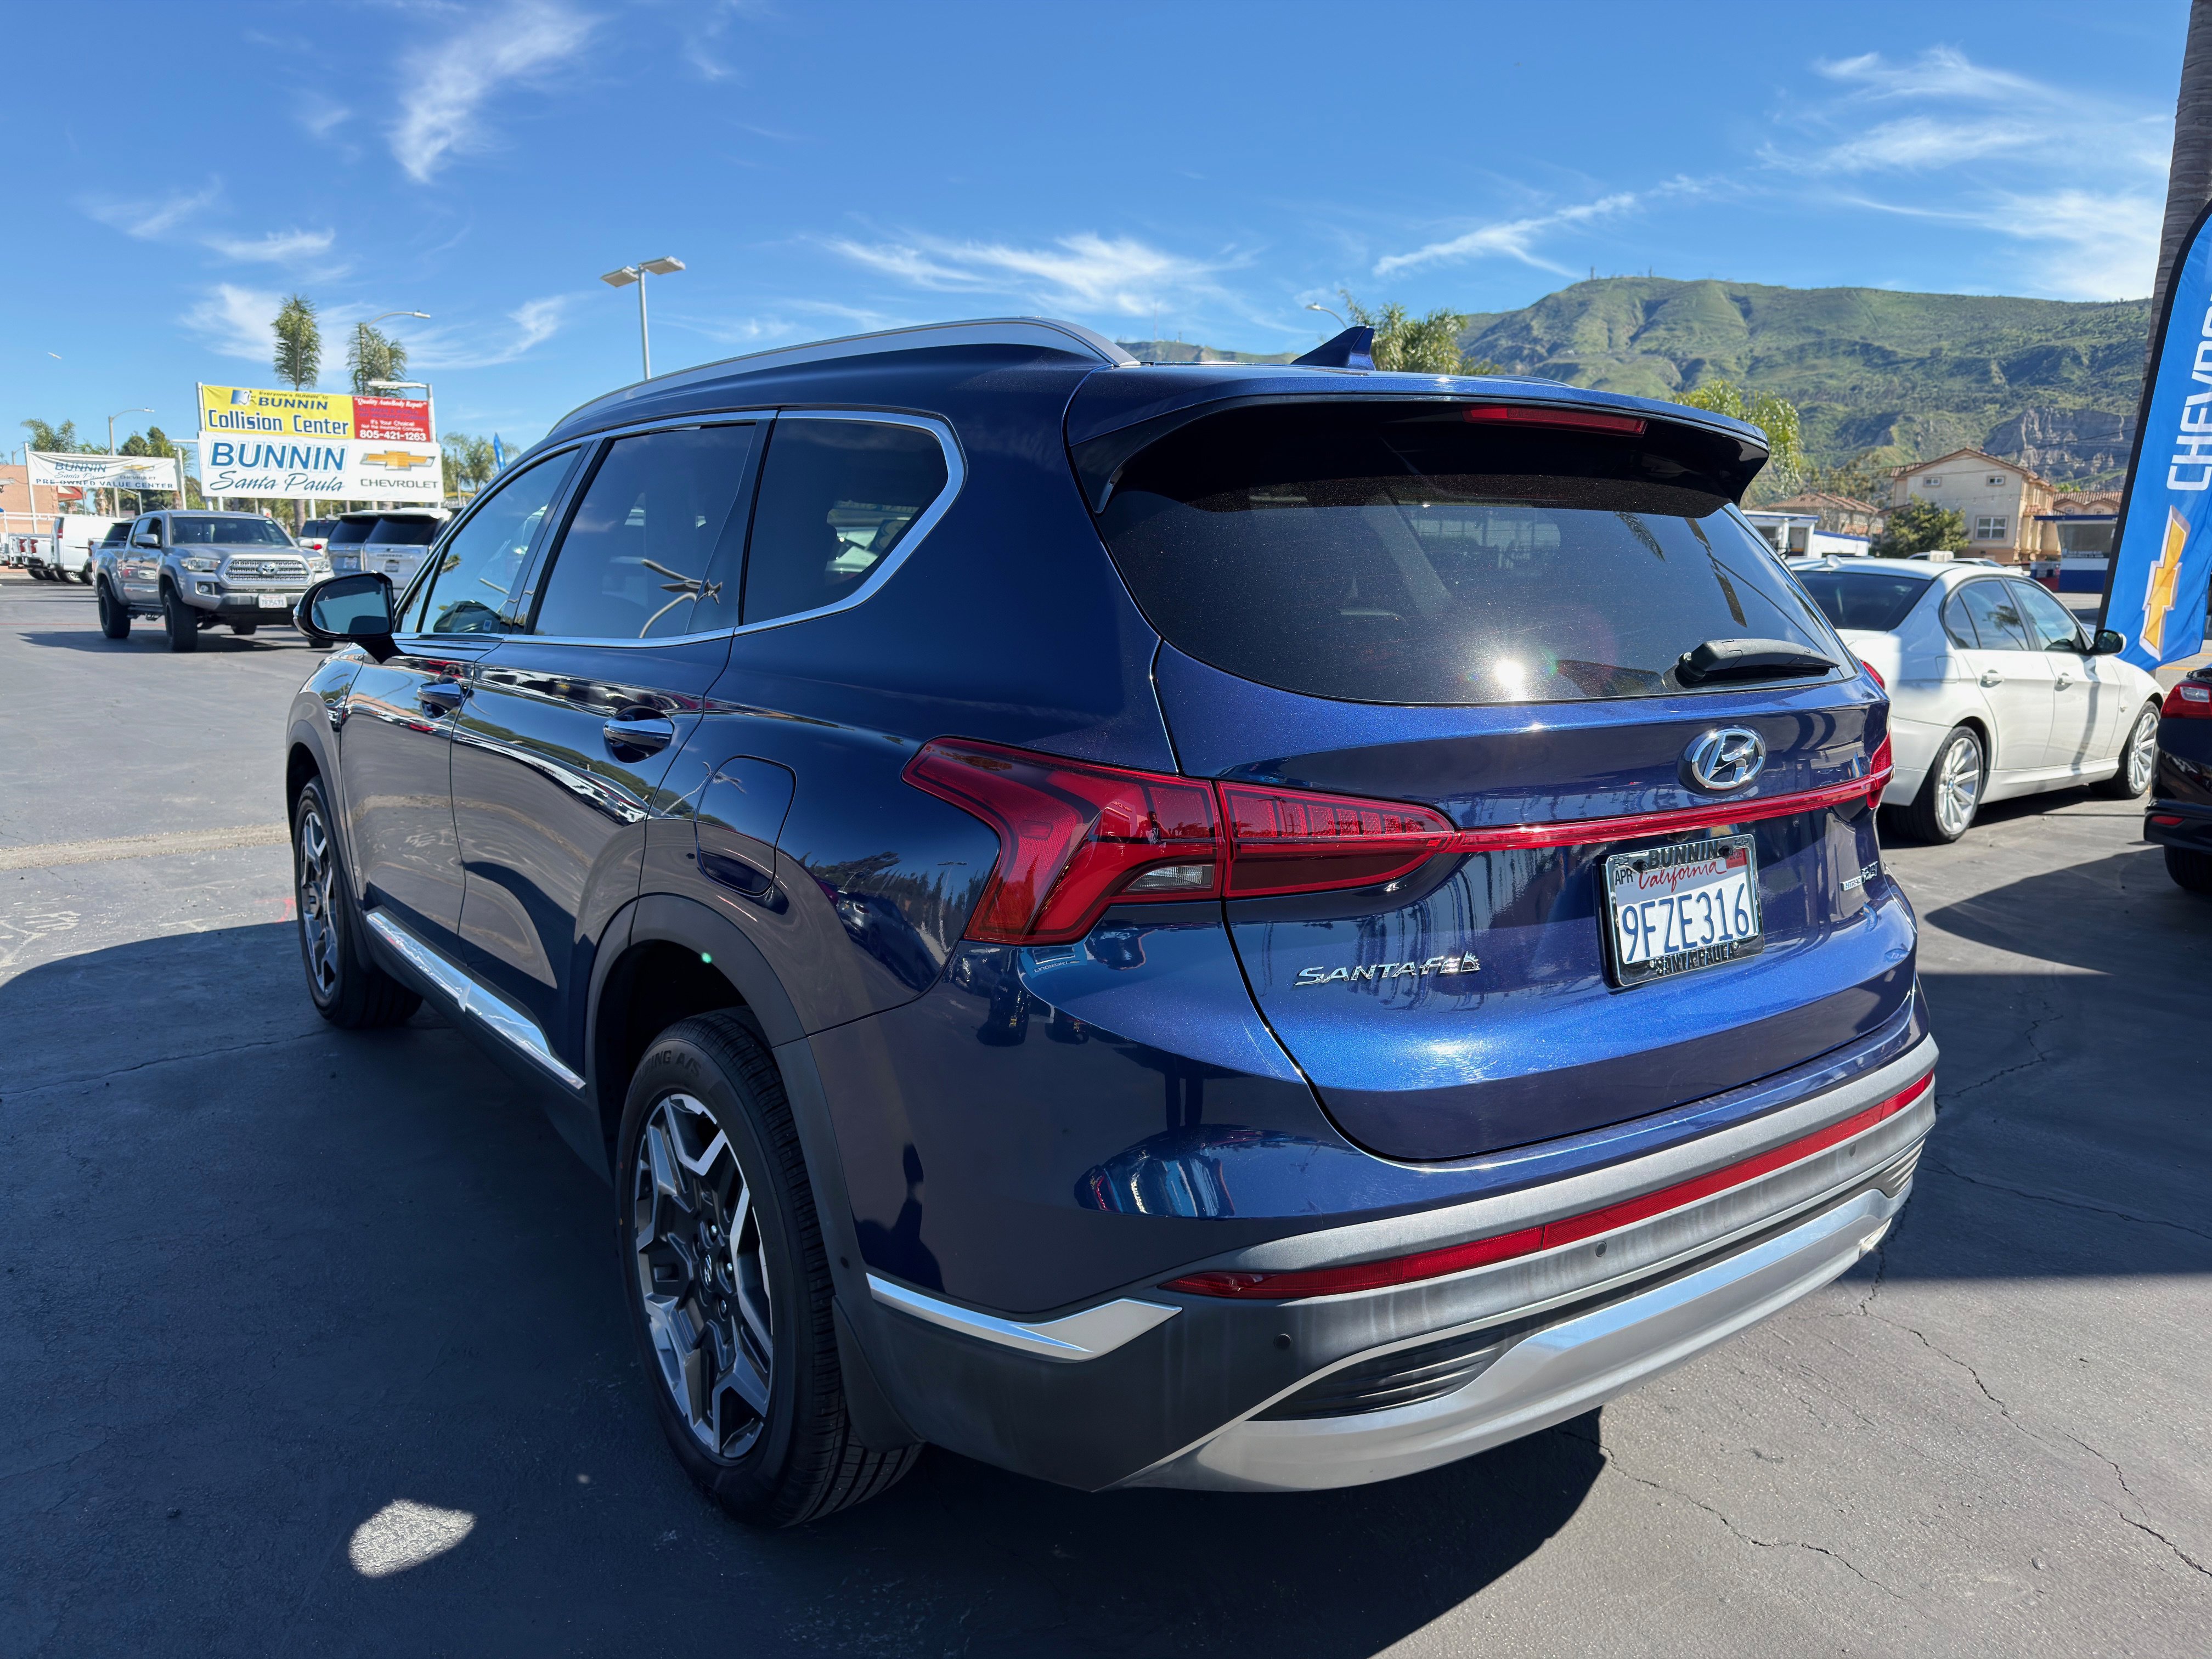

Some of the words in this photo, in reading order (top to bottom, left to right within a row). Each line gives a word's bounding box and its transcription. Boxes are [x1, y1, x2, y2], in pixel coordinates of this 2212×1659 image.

[258, 397, 328, 410] BUNNIN
[2166, 299, 2212, 490] CHEV
[208, 410, 283, 431] Collision
[293, 415, 349, 435] Center
[359, 429, 426, 441] 805-421-1263
[55, 461, 107, 472] BUNNIN
[210, 441, 346, 471] BUNNIN
[210, 471, 276, 490] Santa
[285, 472, 345, 492] Paula
[360, 478, 438, 489] CHEVROLET
[1647, 840, 1719, 870] BUNNIN
[1615, 868, 1634, 886] APR
[1638, 860, 1727, 893] California
[1622, 883, 1750, 962] 9FZE316
[1294, 961, 1417, 986] SANTA
[1419, 955, 1460, 975] FE
[1655, 951, 1696, 977] SANTA
[1696, 941, 1734, 967] PAULA
